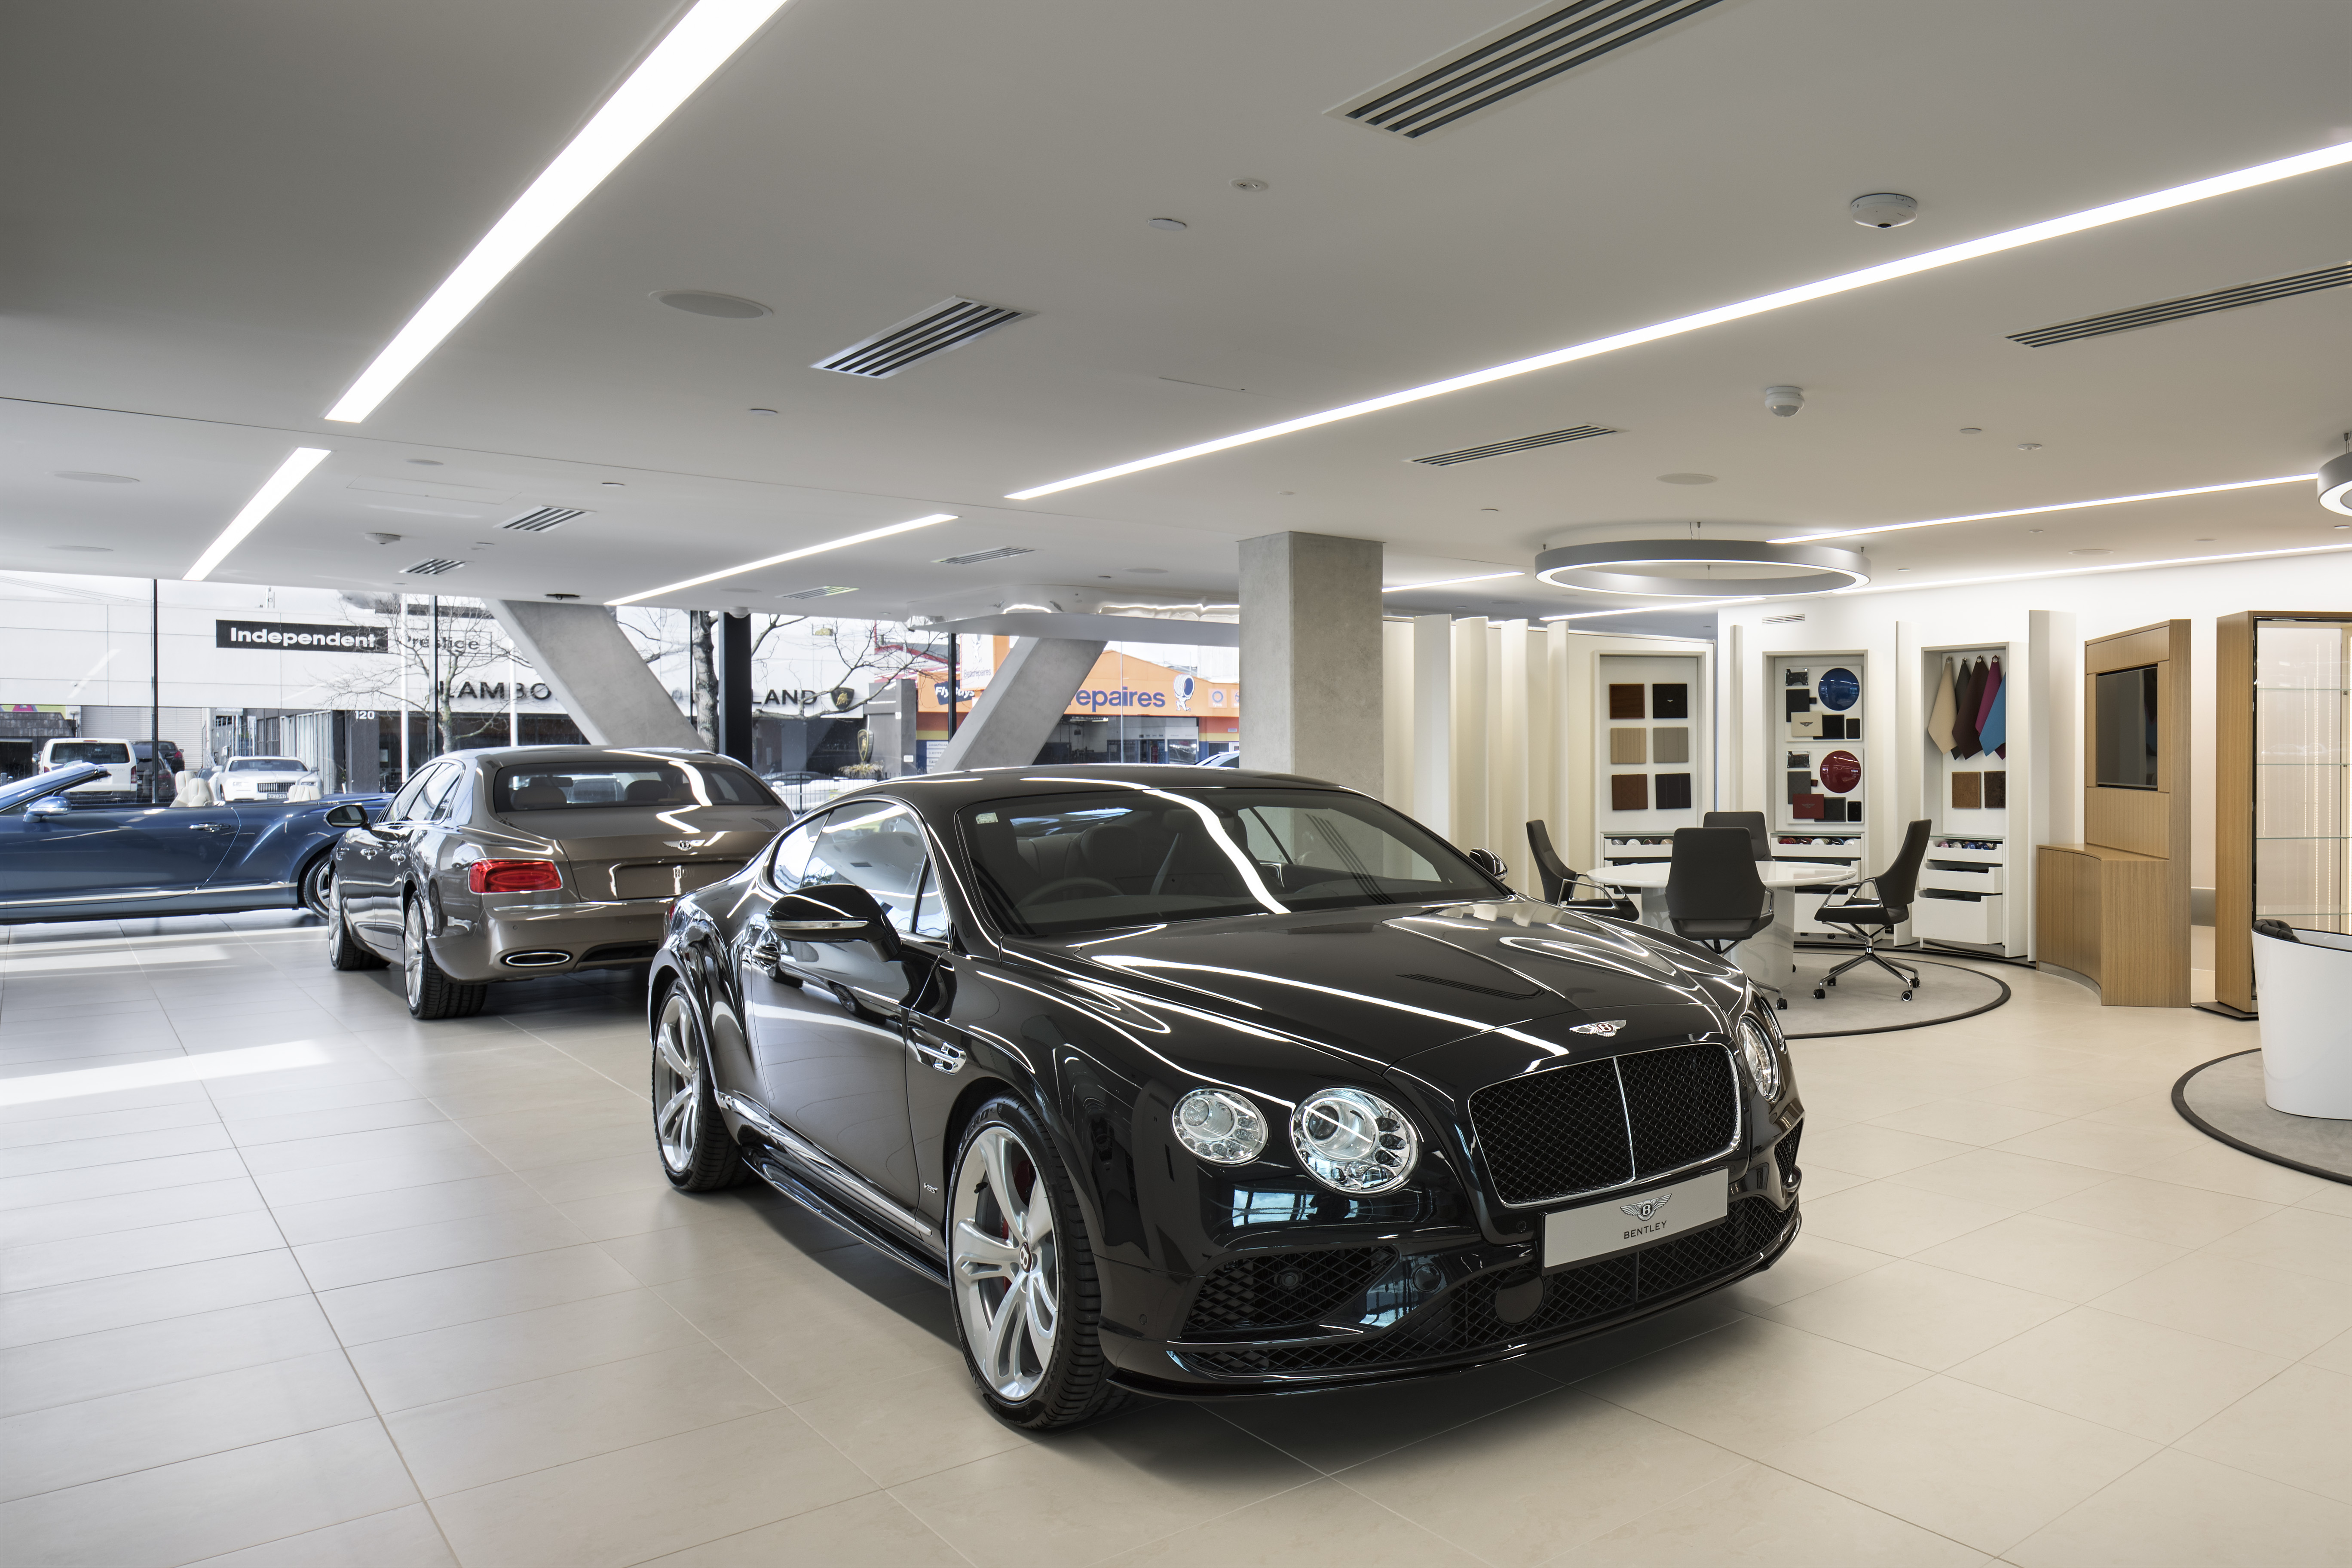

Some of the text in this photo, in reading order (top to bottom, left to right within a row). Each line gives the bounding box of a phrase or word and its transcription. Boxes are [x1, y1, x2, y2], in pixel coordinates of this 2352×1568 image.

[231, 627, 376, 647] Independent
[956, 687, 975, 698] uys
[1069, 686, 1166, 713] epaires
[355, 710, 375, 720] 120
[1642, 1204, 1651, 1216] B
[1624, 1220, 1667, 1239] BENTLEY
